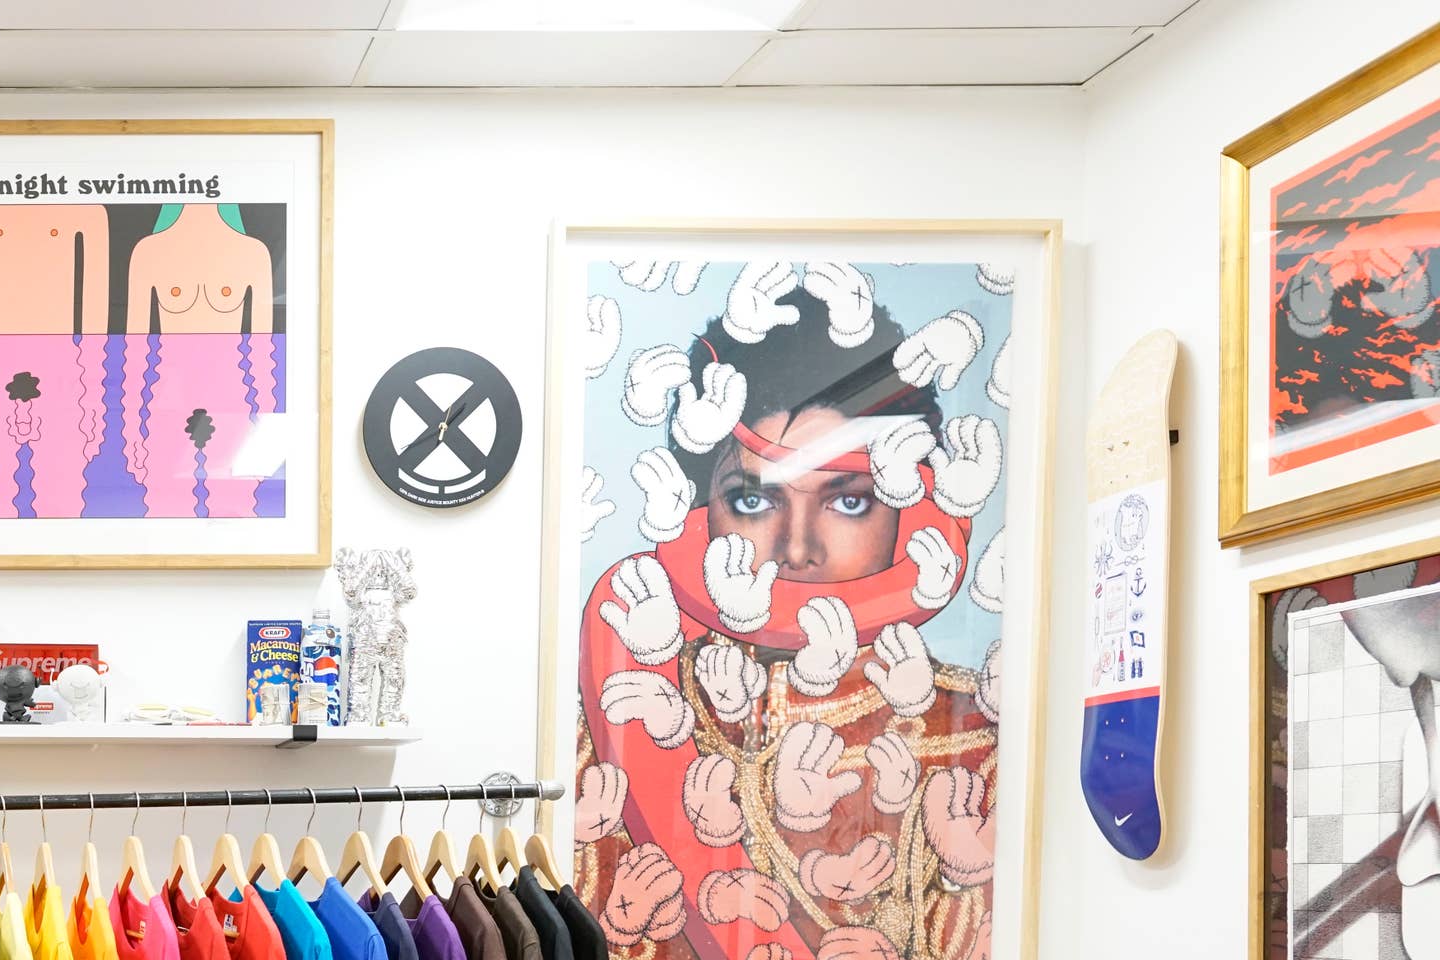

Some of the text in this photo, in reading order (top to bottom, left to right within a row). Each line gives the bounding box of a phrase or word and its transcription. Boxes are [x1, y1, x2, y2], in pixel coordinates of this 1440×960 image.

[78, 172, 221, 198] swimming
[250, 640, 300, 654] Macaroni
[251, 649, 299, 663] & Cheese
